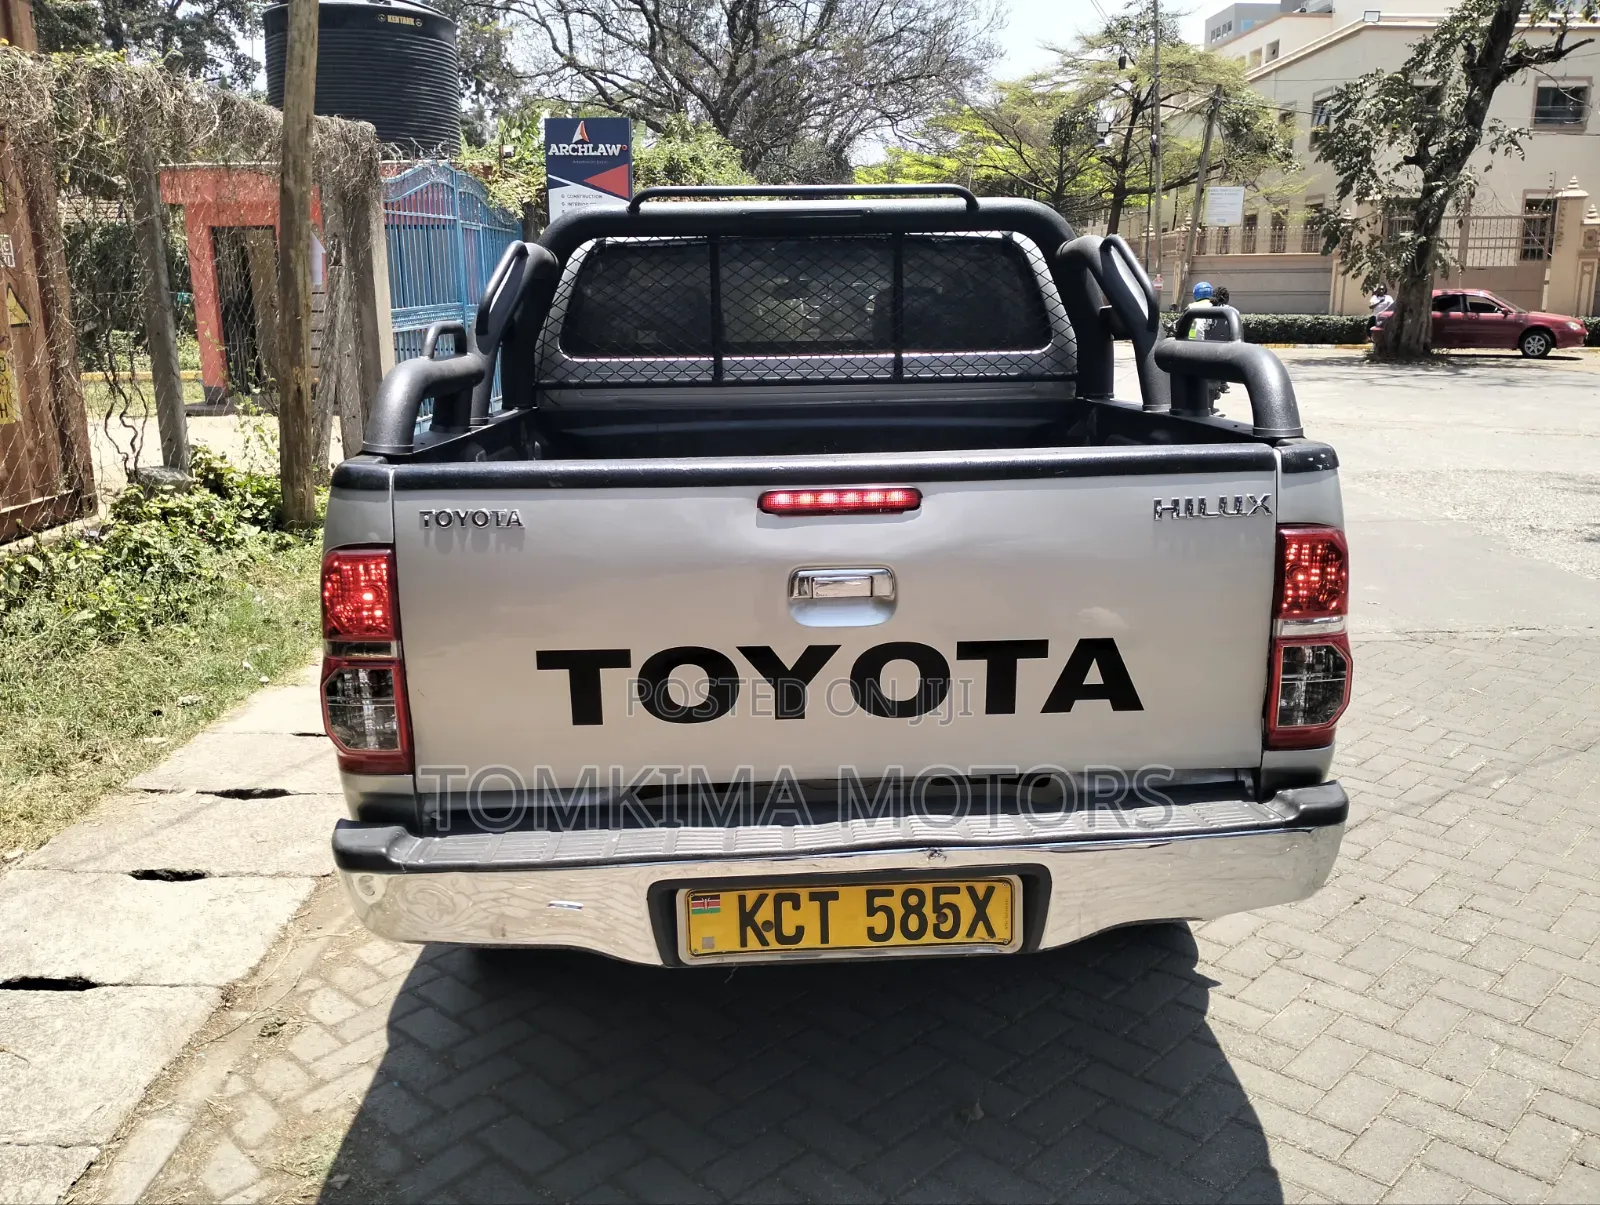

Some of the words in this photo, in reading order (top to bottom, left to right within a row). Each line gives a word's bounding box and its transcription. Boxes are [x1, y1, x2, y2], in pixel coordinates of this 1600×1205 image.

[387, 15, 415, 25] KENTANK
[548, 143, 621, 156] ARCHLAW
[419, 508, 525, 528] TOYOTA
[1153, 493, 1273, 520] HILUX
[536, 638, 1145, 725] TOYOTA
[737, 891, 840, 948] KCT
[865, 886, 996, 943] 585X
